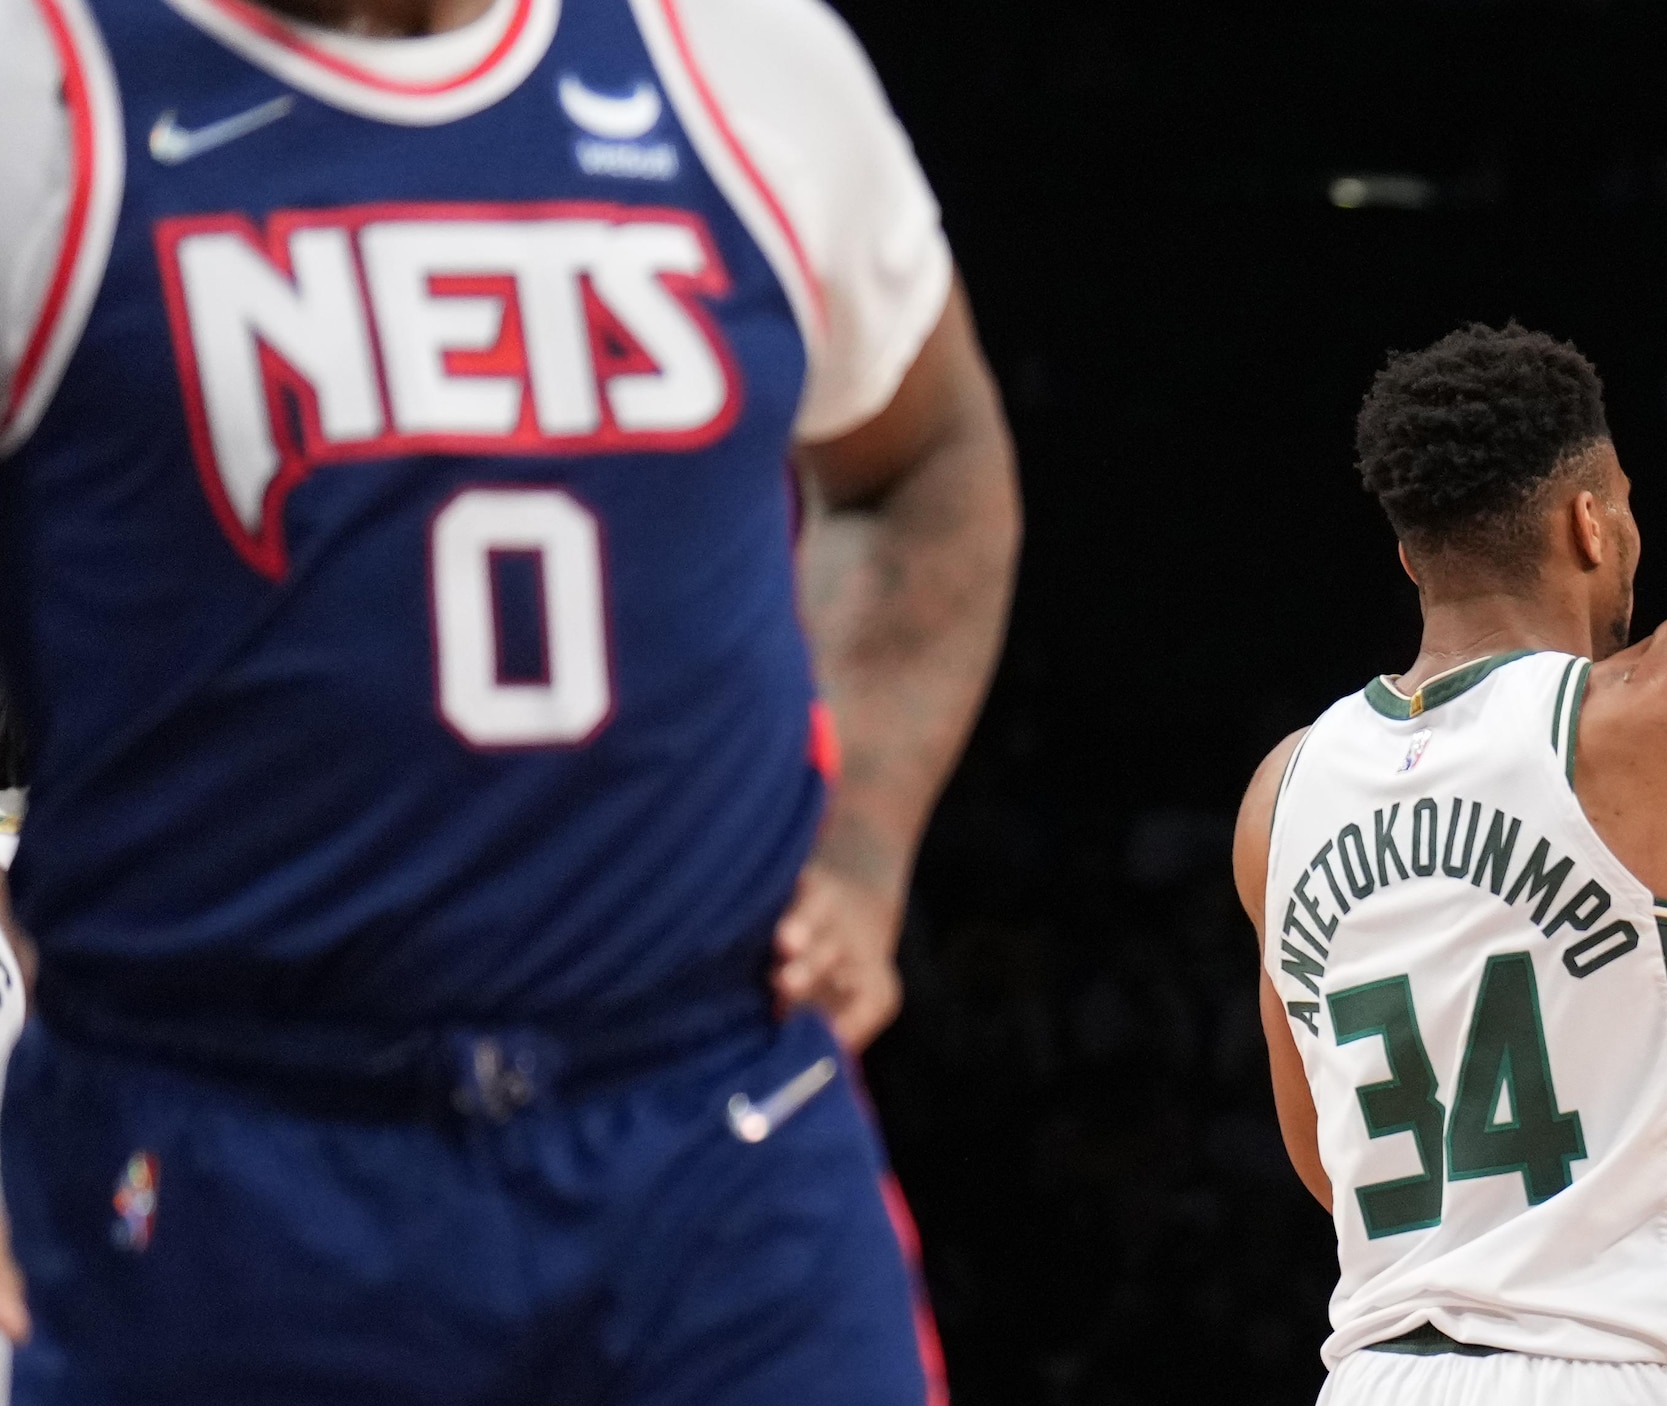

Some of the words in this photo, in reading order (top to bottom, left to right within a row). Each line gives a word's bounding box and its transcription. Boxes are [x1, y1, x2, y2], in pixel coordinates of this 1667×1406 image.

[155, 202, 740, 581] NETS
[430, 483, 614, 748] 0
[1286, 797, 1638, 1037] ANTETOKOUNMPO
[1326, 951, 1588, 1240] 34
